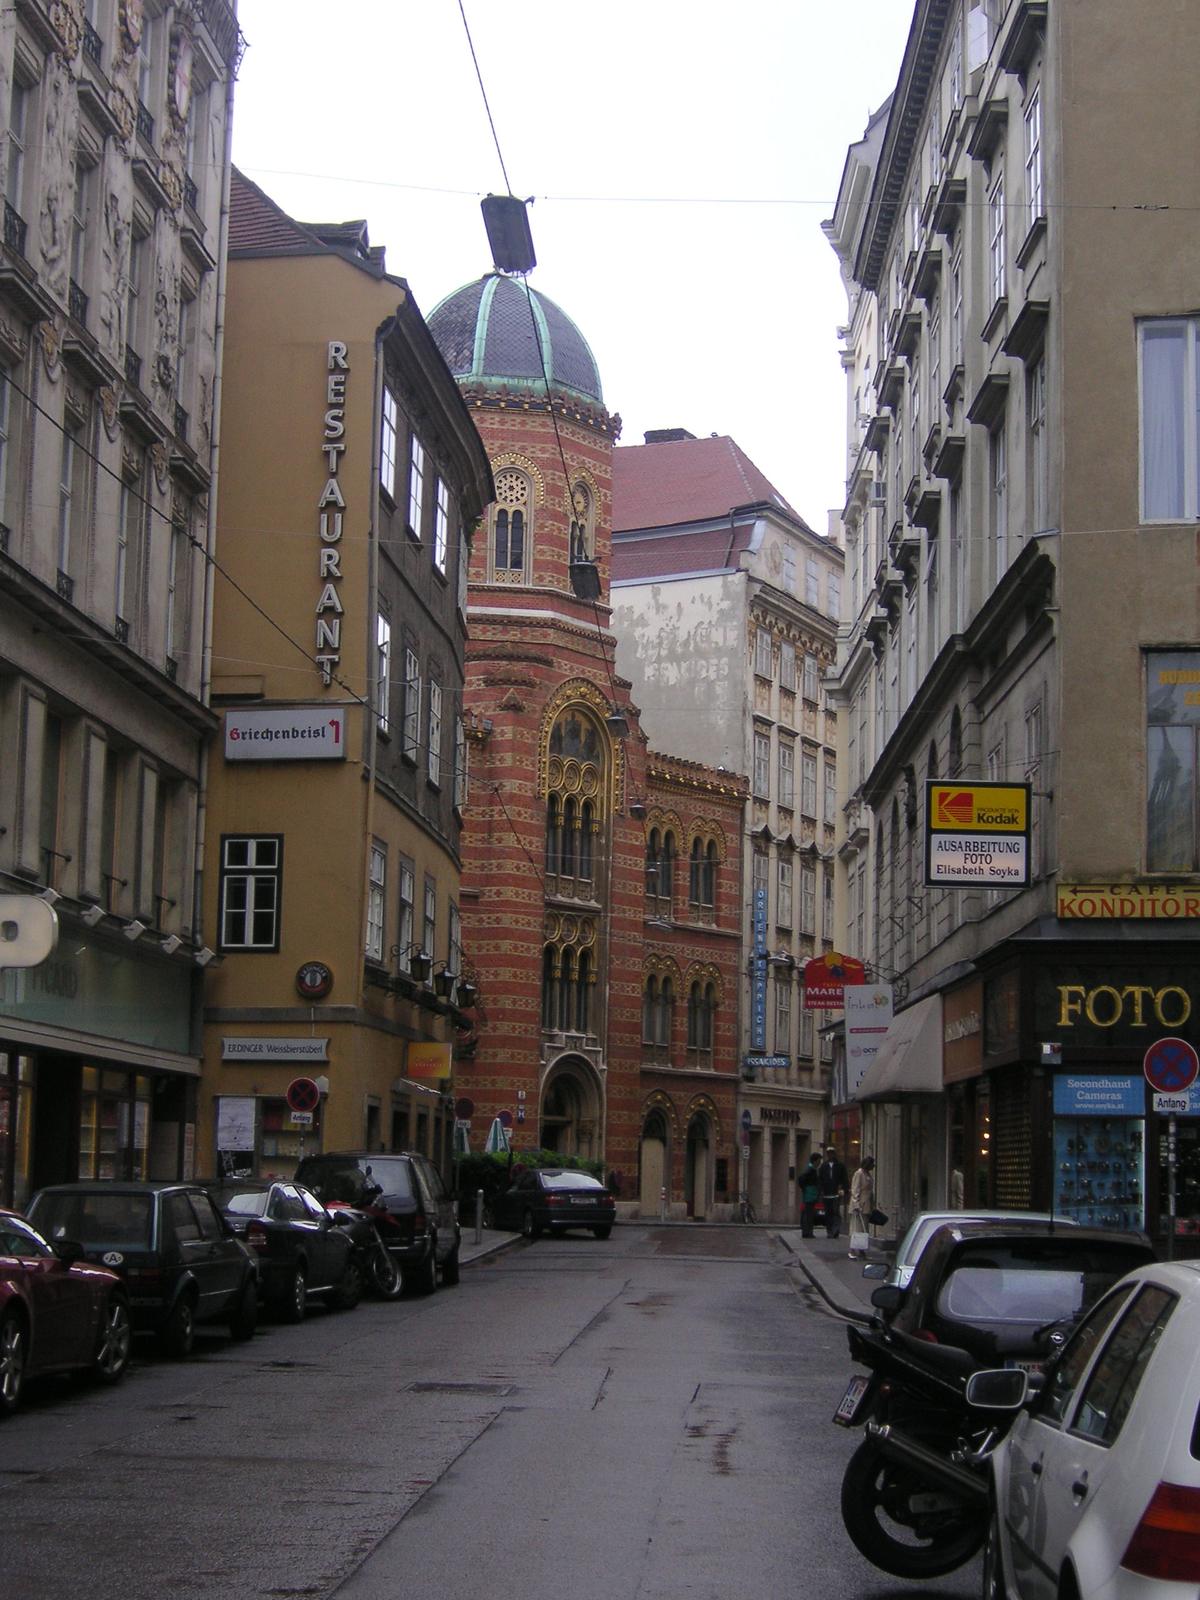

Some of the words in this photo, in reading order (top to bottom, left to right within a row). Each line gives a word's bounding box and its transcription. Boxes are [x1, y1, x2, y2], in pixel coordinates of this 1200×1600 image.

[315, 340, 350, 688] RESTAURANT
[229, 726, 326, 742] Griechenbeisl
[977, 813, 1020, 825] Kodak
[937, 841, 1020, 853] AUSARBEITUNG
[963, 853, 993, 865] FOTO
[936, 865, 985, 875] Elisabeth
[988, 866, 1020, 878] Soyka
[1109, 885, 1177, 896] CAFE
[1059, 898, 1200, 918] KONDITOR
[1056, 985, 1192, 1028] FOTO
[228, 1043, 264, 1054] ERDINGER
[1067, 1079, 1131, 1089] Secondhand
[1076, 1090, 1122, 1101] Cameras
[1157, 1097, 1187, 1110] Anfang
[108, 1253, 118, 1263] A
